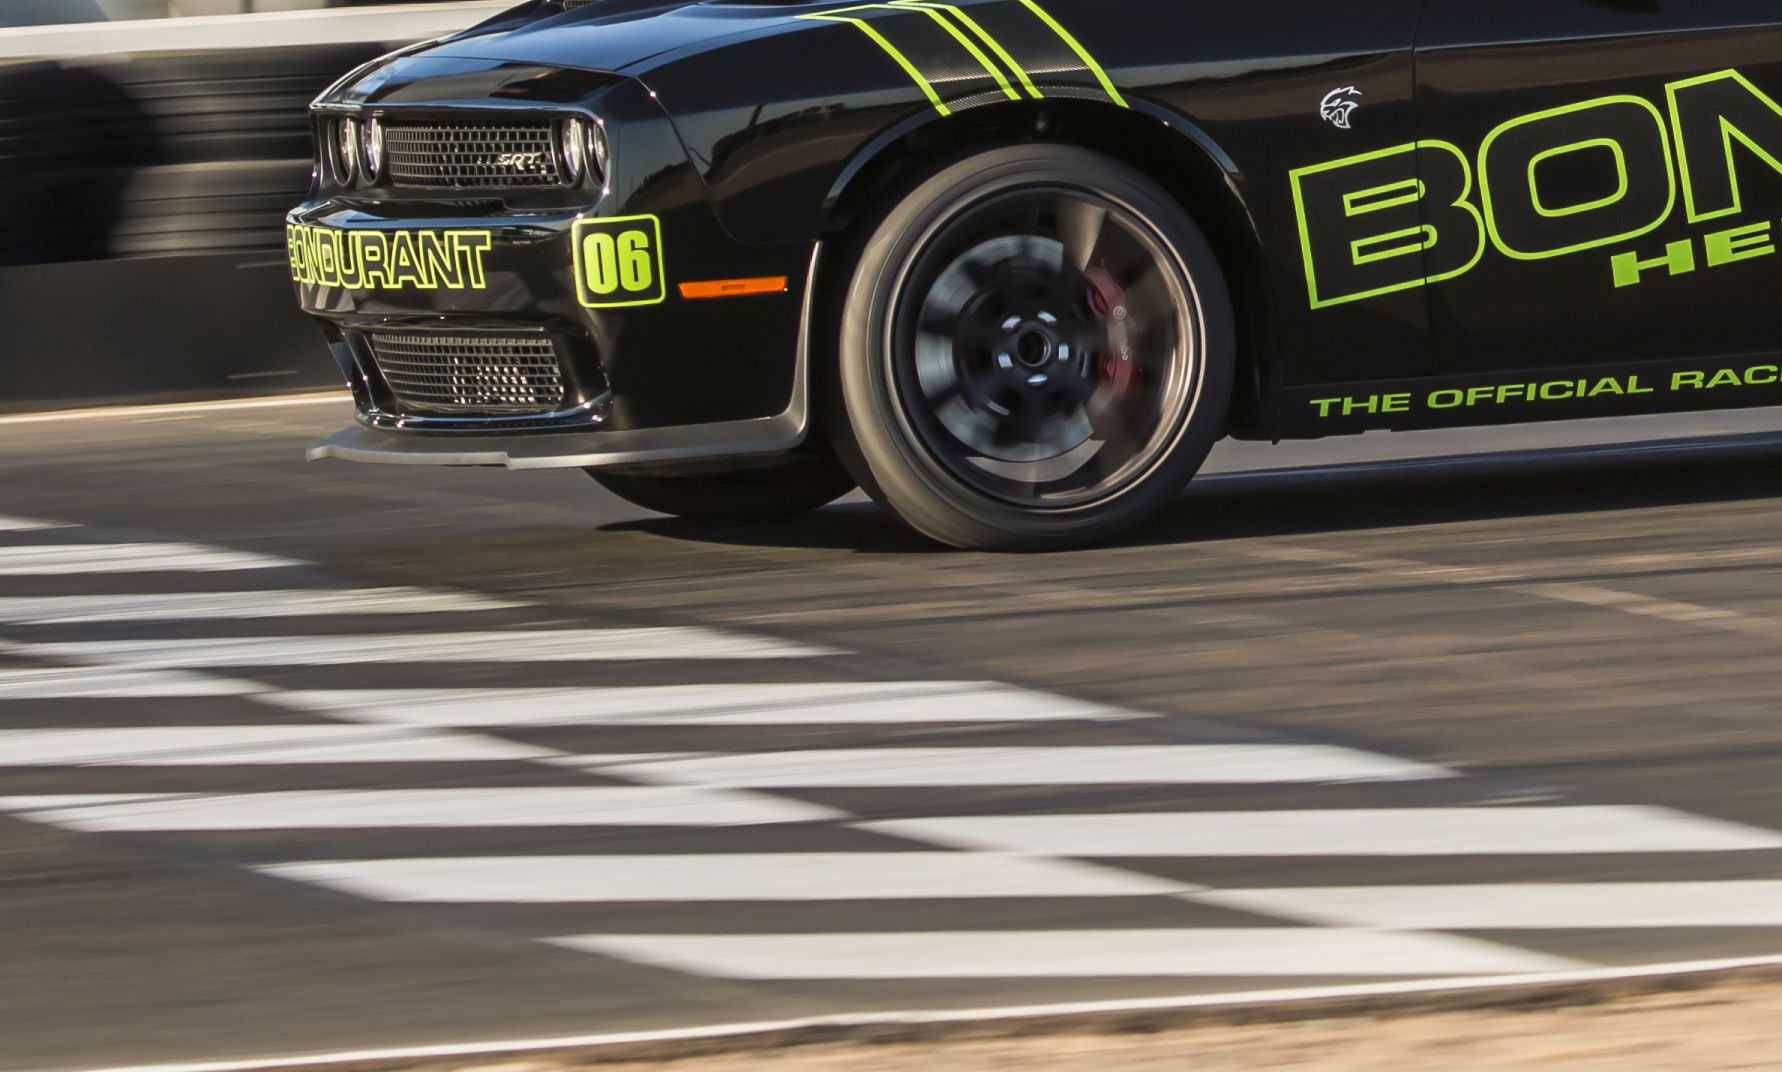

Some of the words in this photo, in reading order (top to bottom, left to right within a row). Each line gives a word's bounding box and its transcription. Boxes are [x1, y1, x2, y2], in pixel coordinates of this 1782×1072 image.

[498, 152, 542, 170] SRT
[583, 230, 653, 295] 06
[1310, 393, 1411, 417] THE
[1427, 375, 1653, 409] OFFICIAL
